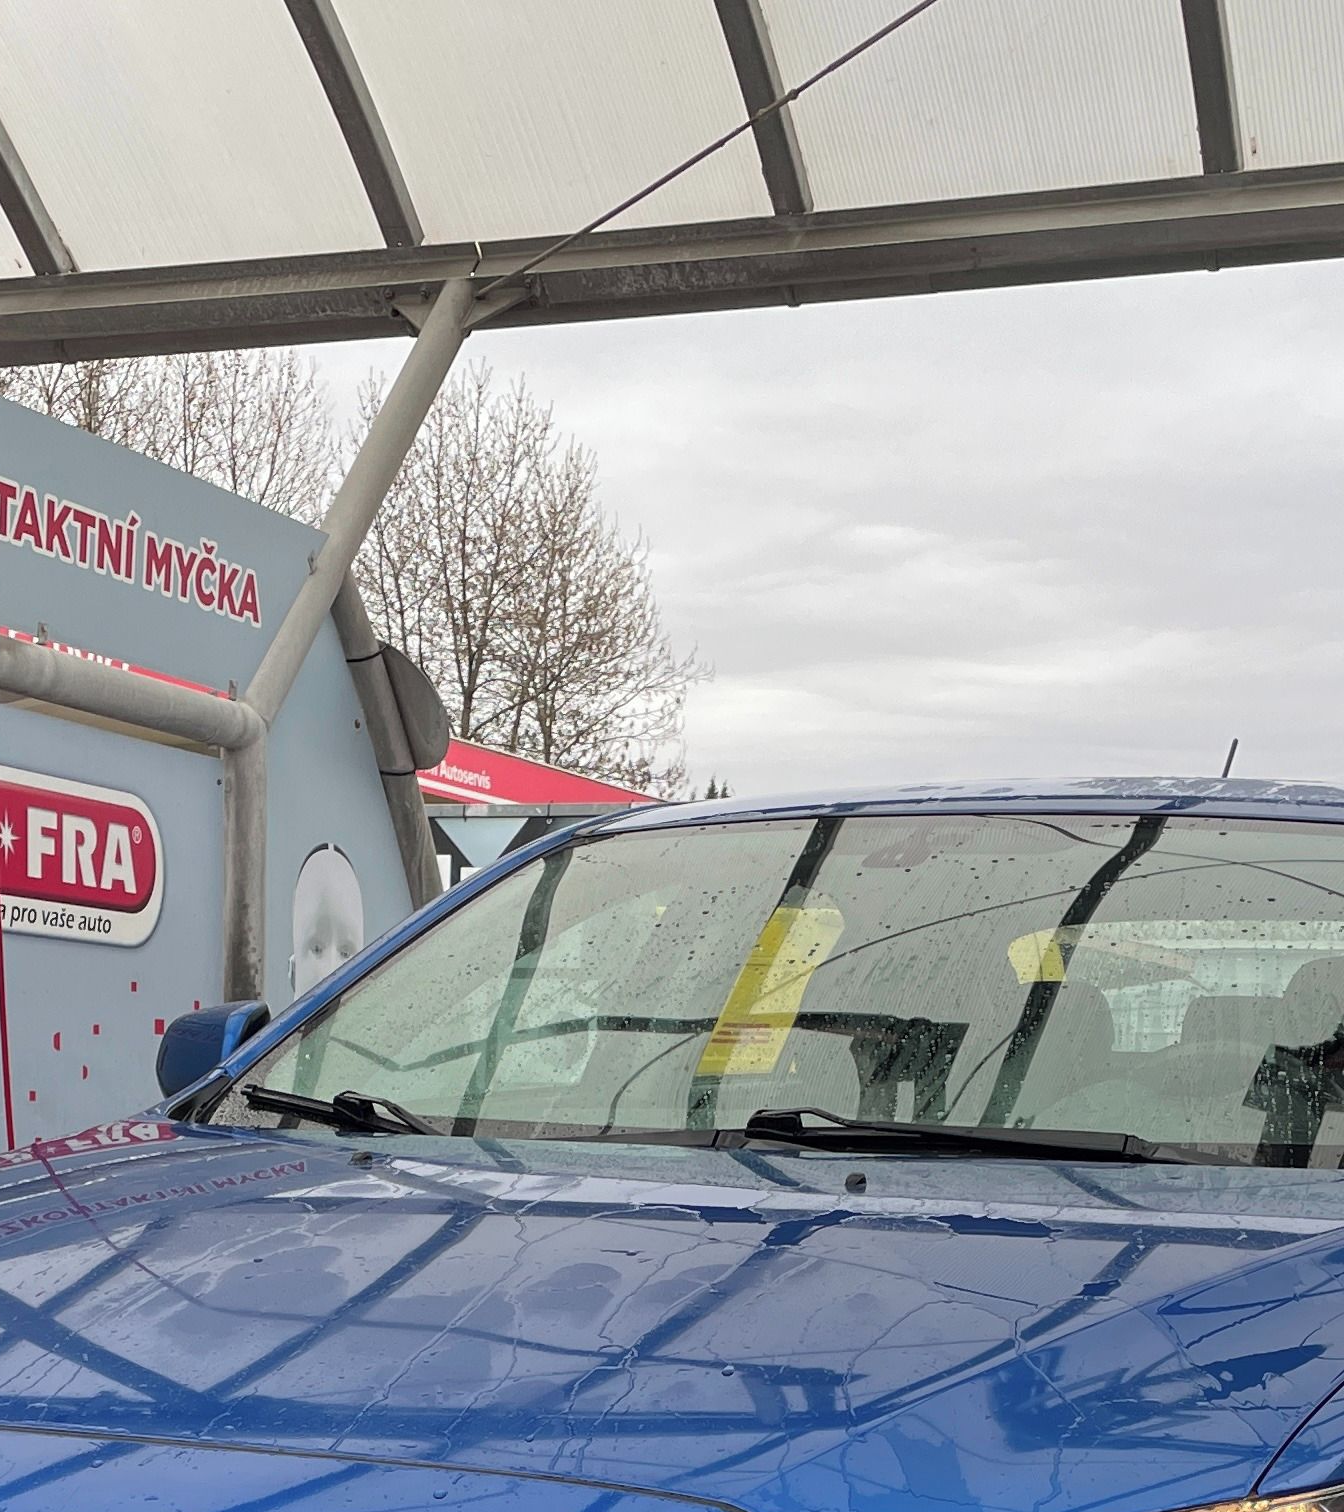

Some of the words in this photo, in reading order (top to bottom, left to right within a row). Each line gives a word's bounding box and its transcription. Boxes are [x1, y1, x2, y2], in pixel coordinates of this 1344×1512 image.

[145, 536, 260, 624] MYČKA
[439, 759, 492, 790] Autoservis
[9, 903, 37, 928] pro
[41, 907, 75, 930] vaše
[78, 913, 112, 934] auto
